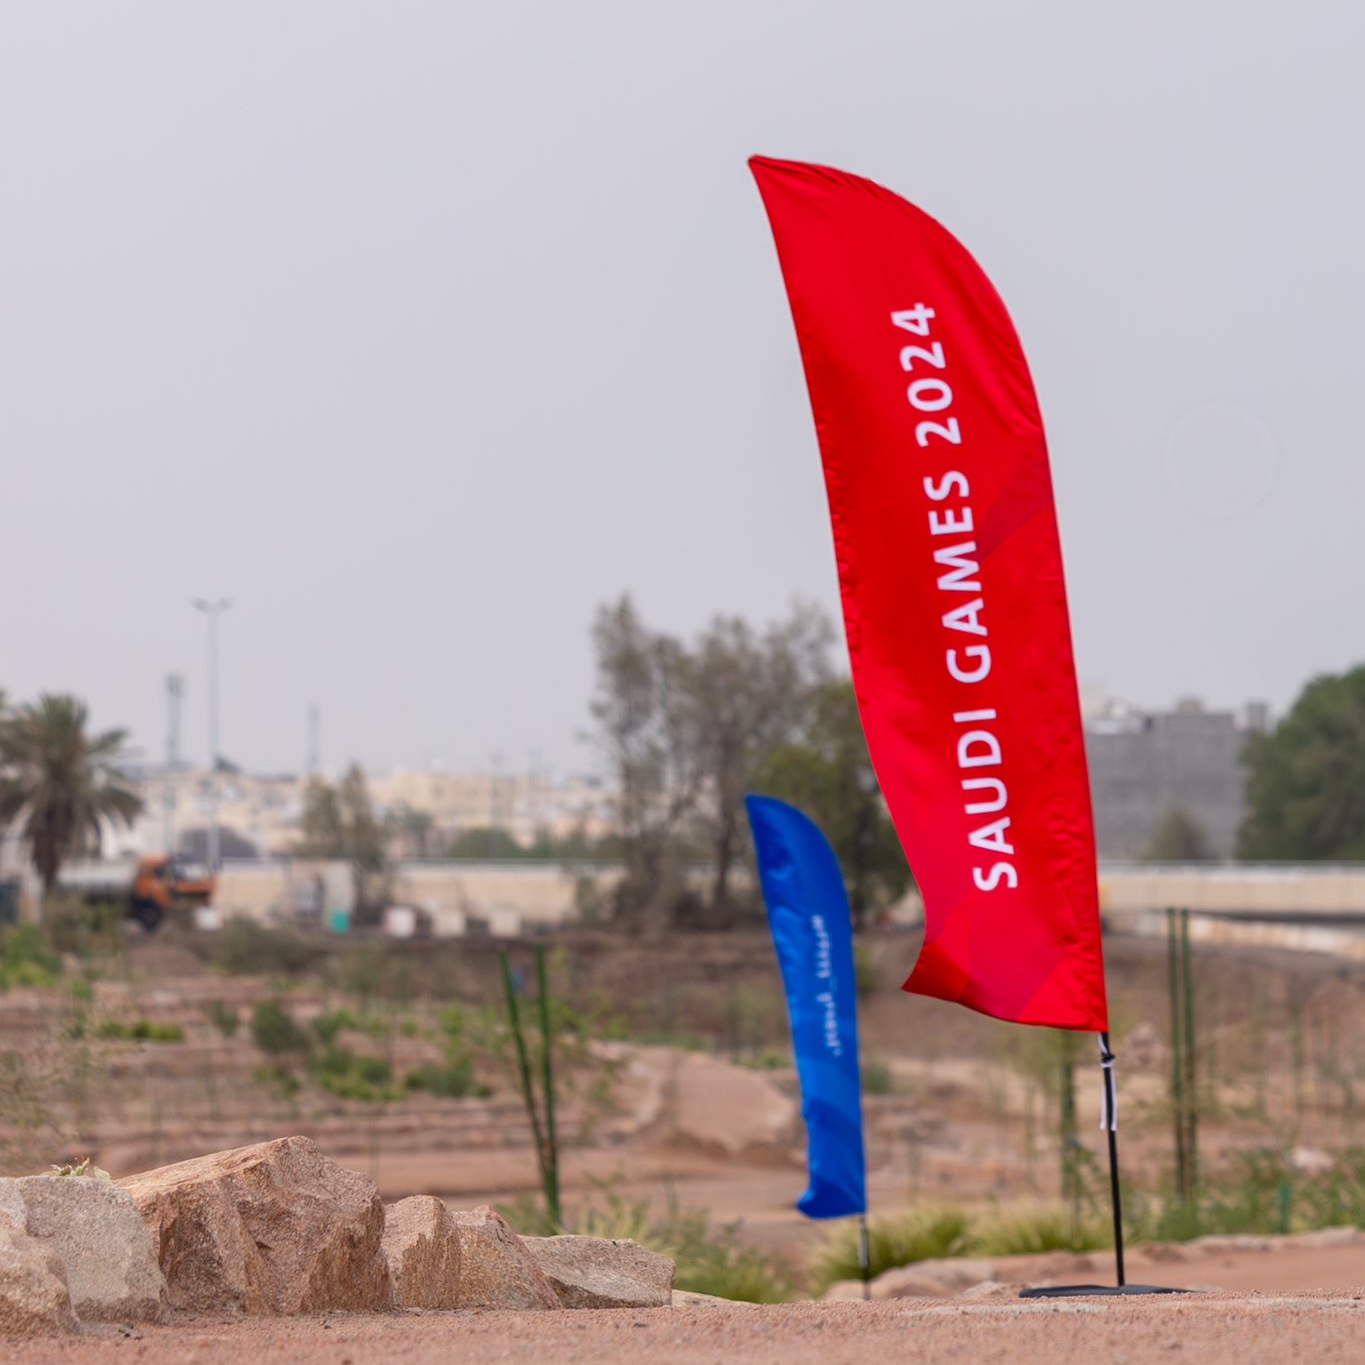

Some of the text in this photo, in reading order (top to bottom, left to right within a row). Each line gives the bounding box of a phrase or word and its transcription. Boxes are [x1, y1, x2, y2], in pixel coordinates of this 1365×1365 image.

[890, 302, 1019, 894] SAUDI GAMES 2024
